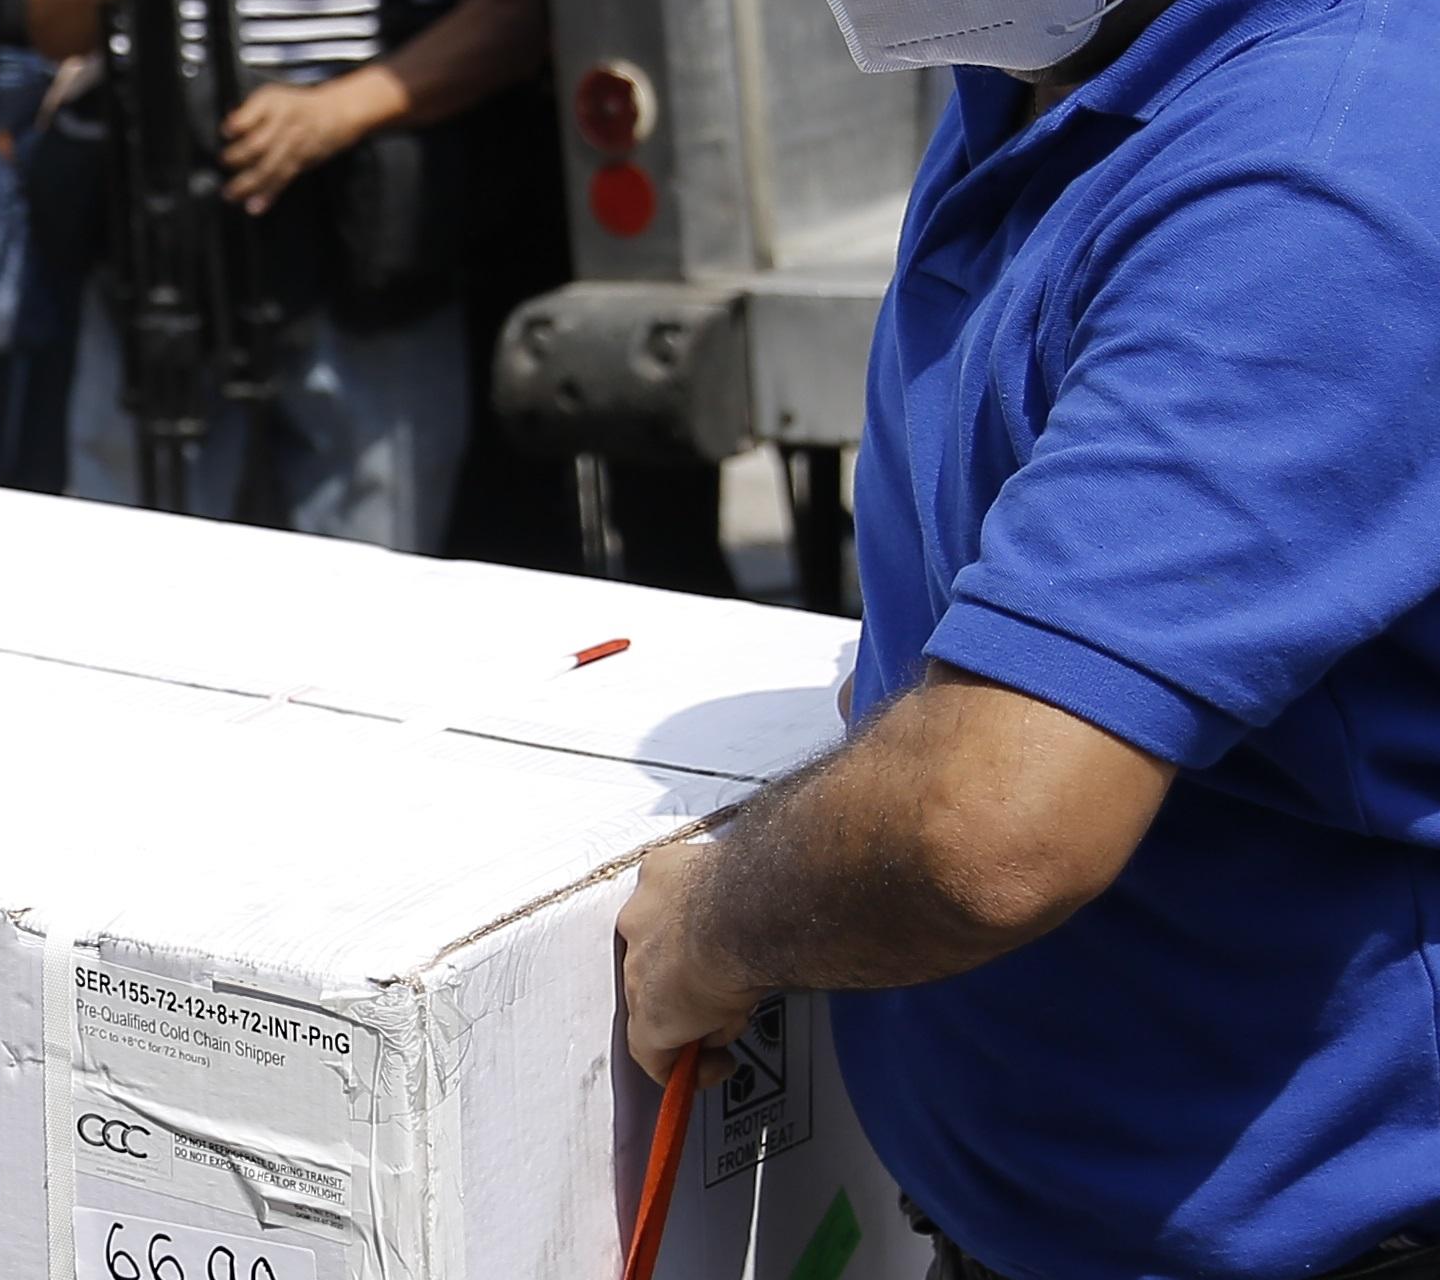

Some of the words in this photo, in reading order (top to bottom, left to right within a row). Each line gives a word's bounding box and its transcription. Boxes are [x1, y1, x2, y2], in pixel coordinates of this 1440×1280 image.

[75, 966, 350, 1055] SER-155-72-12+8+72-INT-PnG
[76, 998, 156, 1035] Pre-Qualified
[159, 1021, 190, 1043] Cold
[193, 1029, 231, 1053] Chain
[235, 1041, 285, 1067] Shipper
[109, 1032, 119, 1042] to
[149, 1042, 161, 1054] for
[163, 1045, 176, 1058] 72
[179, 1049, 211, 1068] hours)
[724, 1098, 787, 1144] PROTECT
[174, 1132, 187, 1145] DO
[189, 1136, 207, 1150] NOT
[269, 1162, 303, 1178] DURING
[174, 1146, 188, 1158] DO
[189, 1150, 207, 1162] NOT
[209, 1155, 242, 1174] EXPOSE
[243, 1166, 255, 1177] TO
[257, 1170, 280, 1187] HEAT
[283, 1177, 296, 1189] OR
[717, 1141, 758, 1175] FROM
[758, 1121, 795, 1156] HEAT
